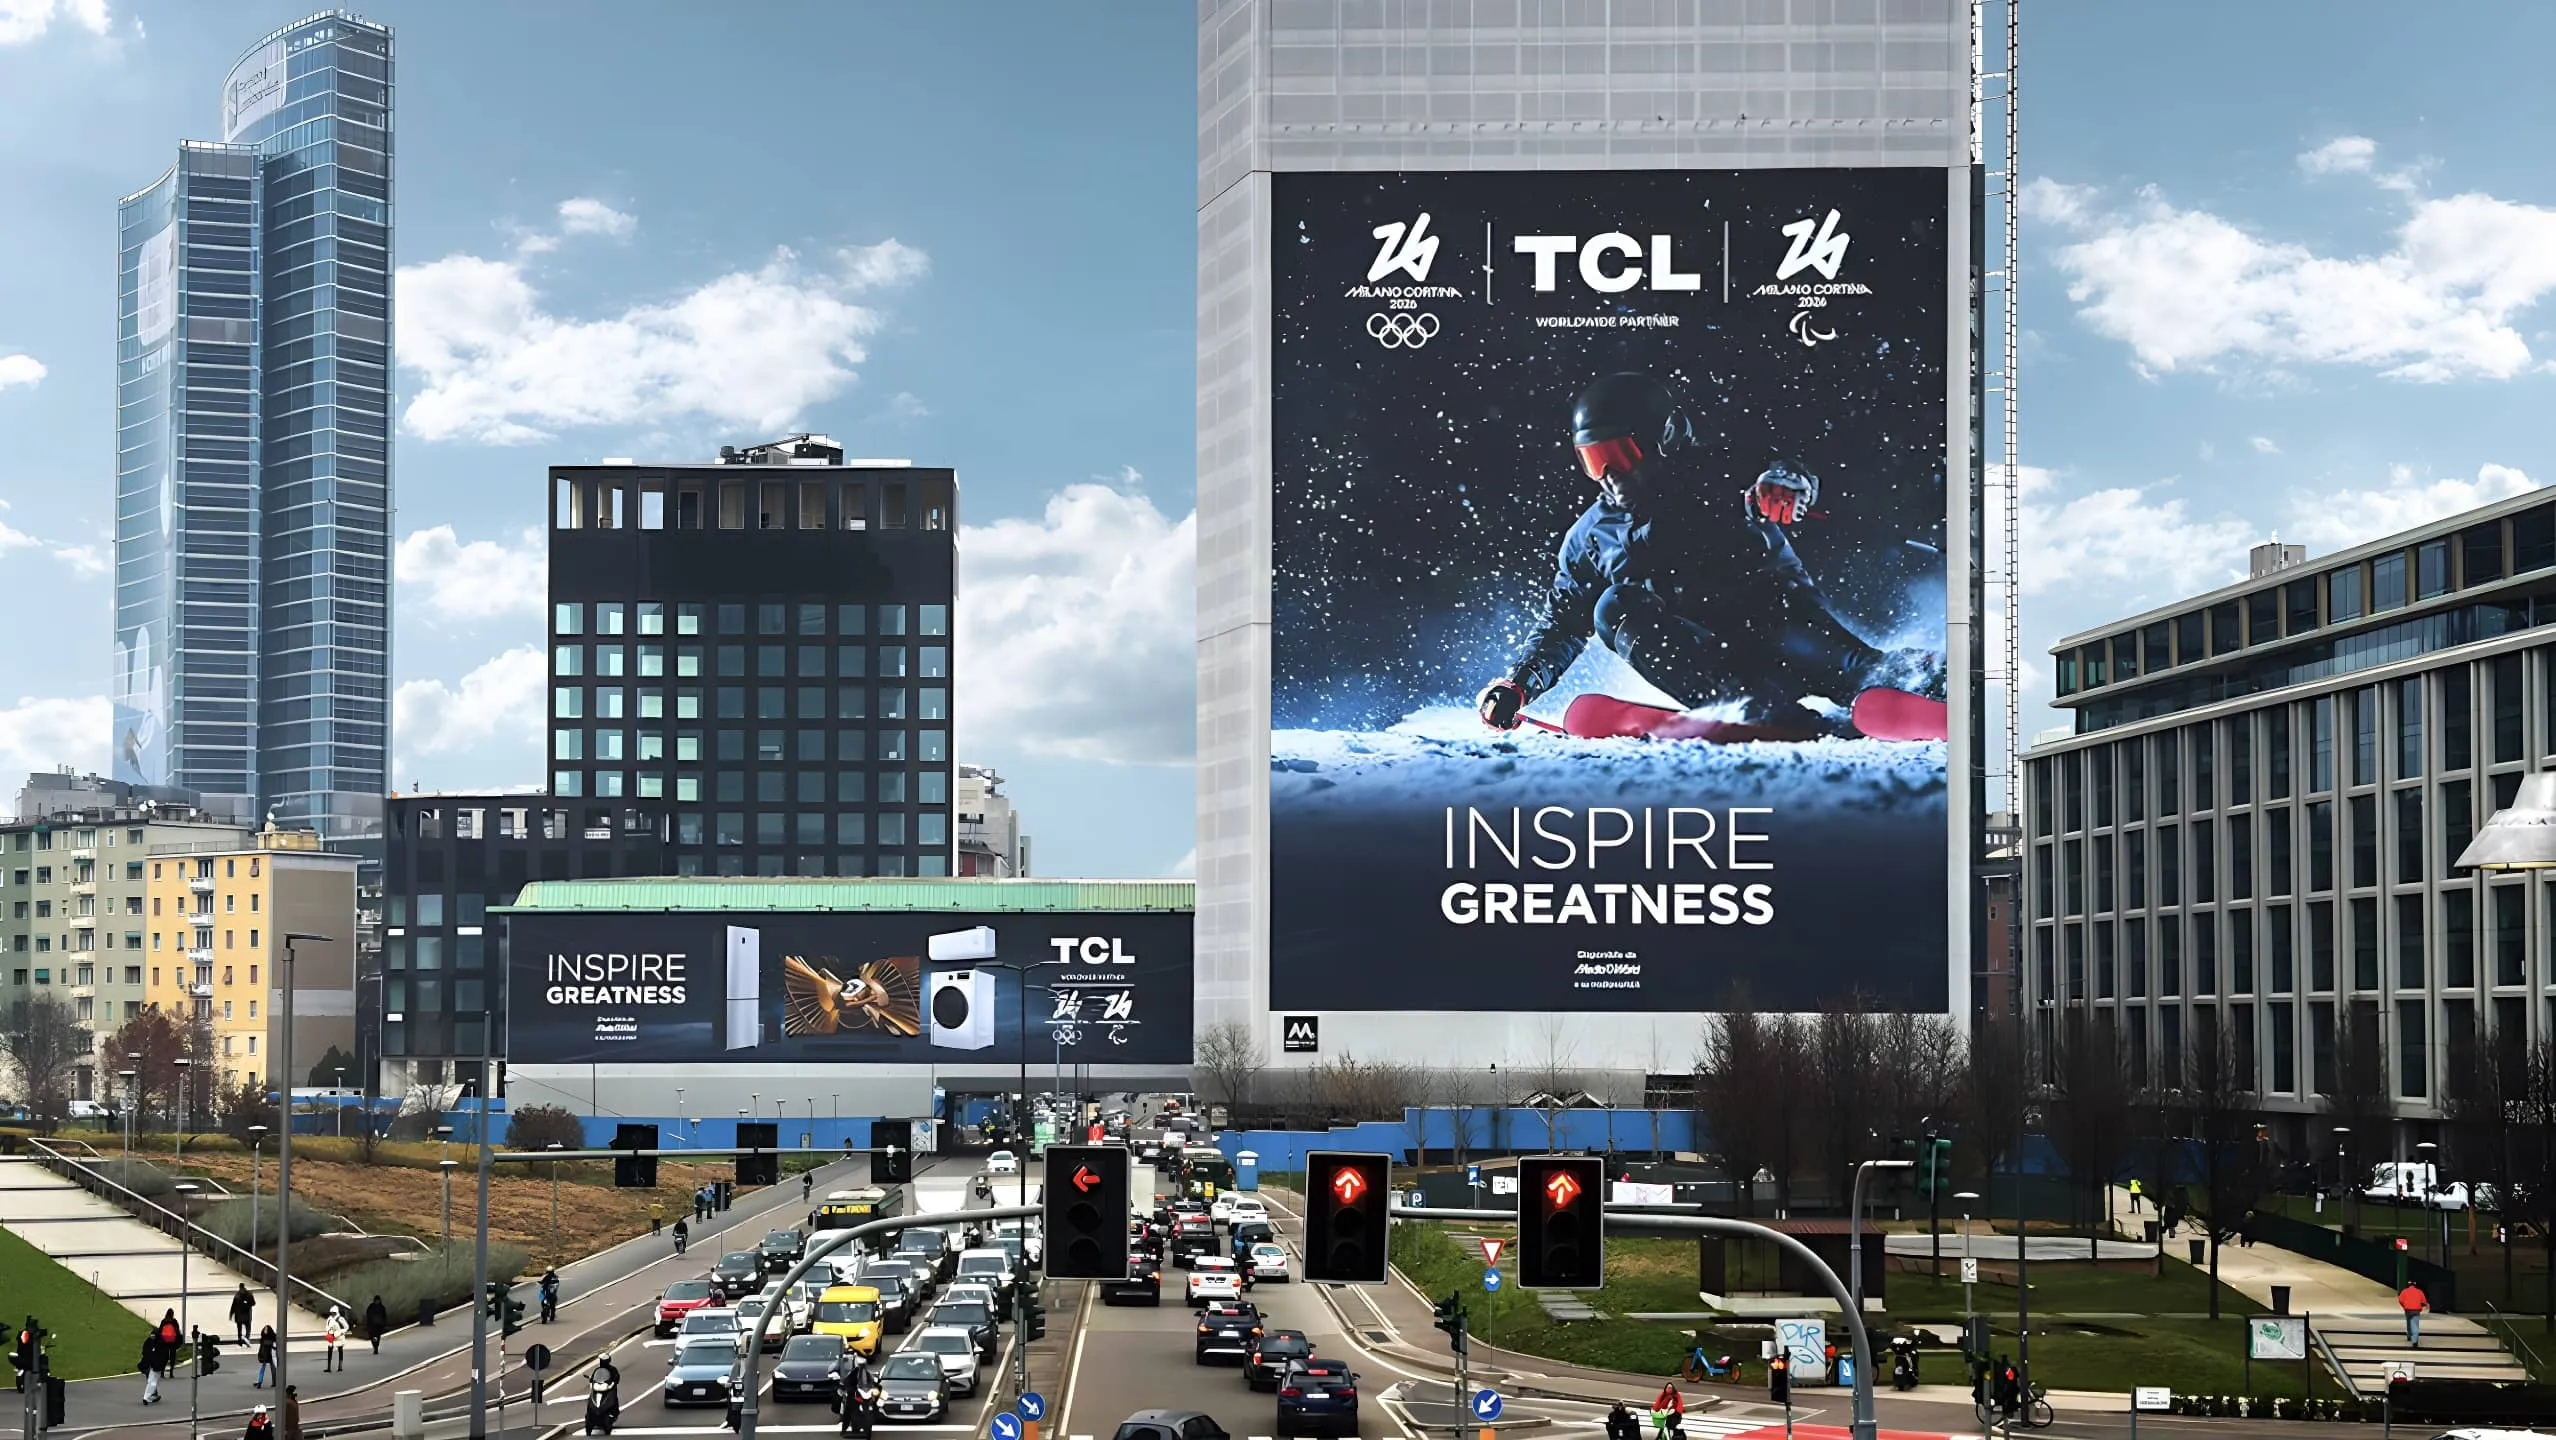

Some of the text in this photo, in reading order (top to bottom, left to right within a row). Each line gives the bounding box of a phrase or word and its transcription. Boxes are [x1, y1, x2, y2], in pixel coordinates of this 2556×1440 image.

[1514, 232, 1701, 293] TCL
[1403, 286, 1462, 298] CORTINA
[1535, 314, 1680, 328] WORLDWIDE PARTNER
[1446, 806, 1774, 870] INSPIRE
[1440, 883, 1774, 925] GREATNESS
[1050, 936, 1136, 965] TCL
[548, 953, 686, 982] INSPIRE
[546, 985, 686, 1005] GREATNESS
